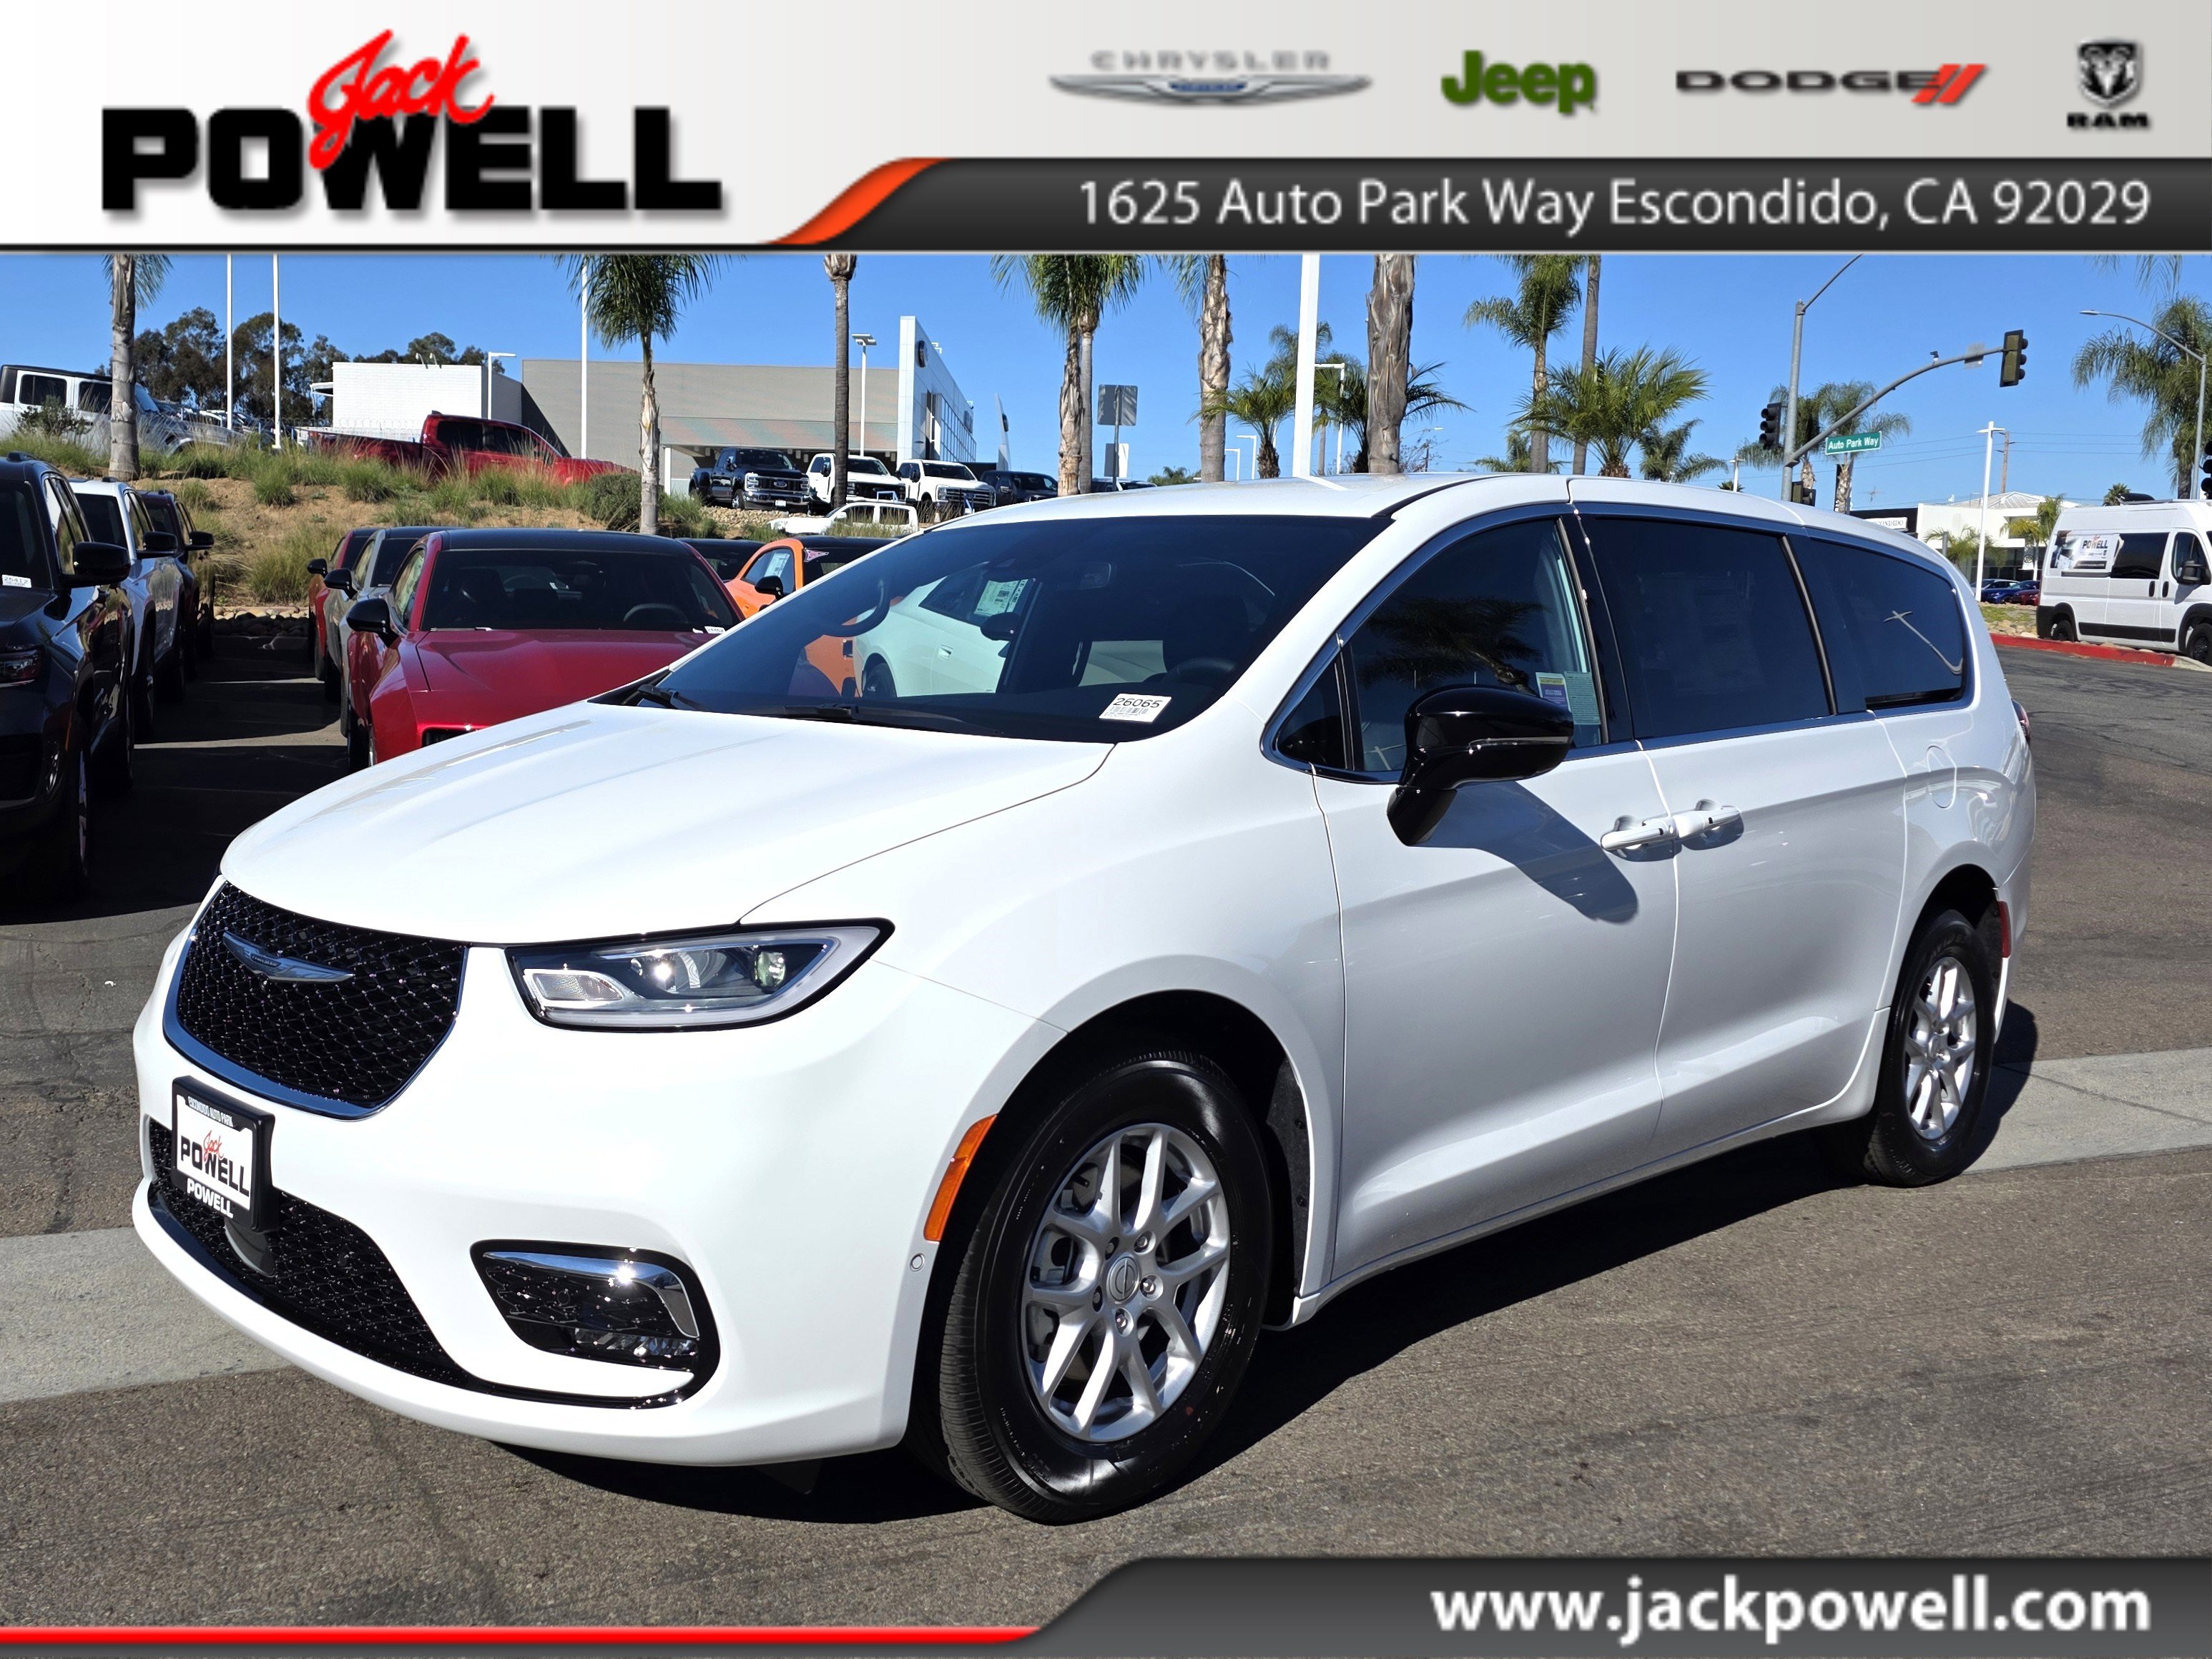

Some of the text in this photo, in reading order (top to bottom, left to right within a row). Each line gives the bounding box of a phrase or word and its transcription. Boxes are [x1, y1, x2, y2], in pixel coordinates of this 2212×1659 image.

[1828, 437, 1879, 450] Auto Park Way
[2082, 539, 2108, 549] POWELL
[1112, 697, 1164, 709] 26065
[203, 1129, 225, 1162] Jack
[180, 1135, 250, 1198] POWELL
[187, 1178, 234, 1219] POWELL
